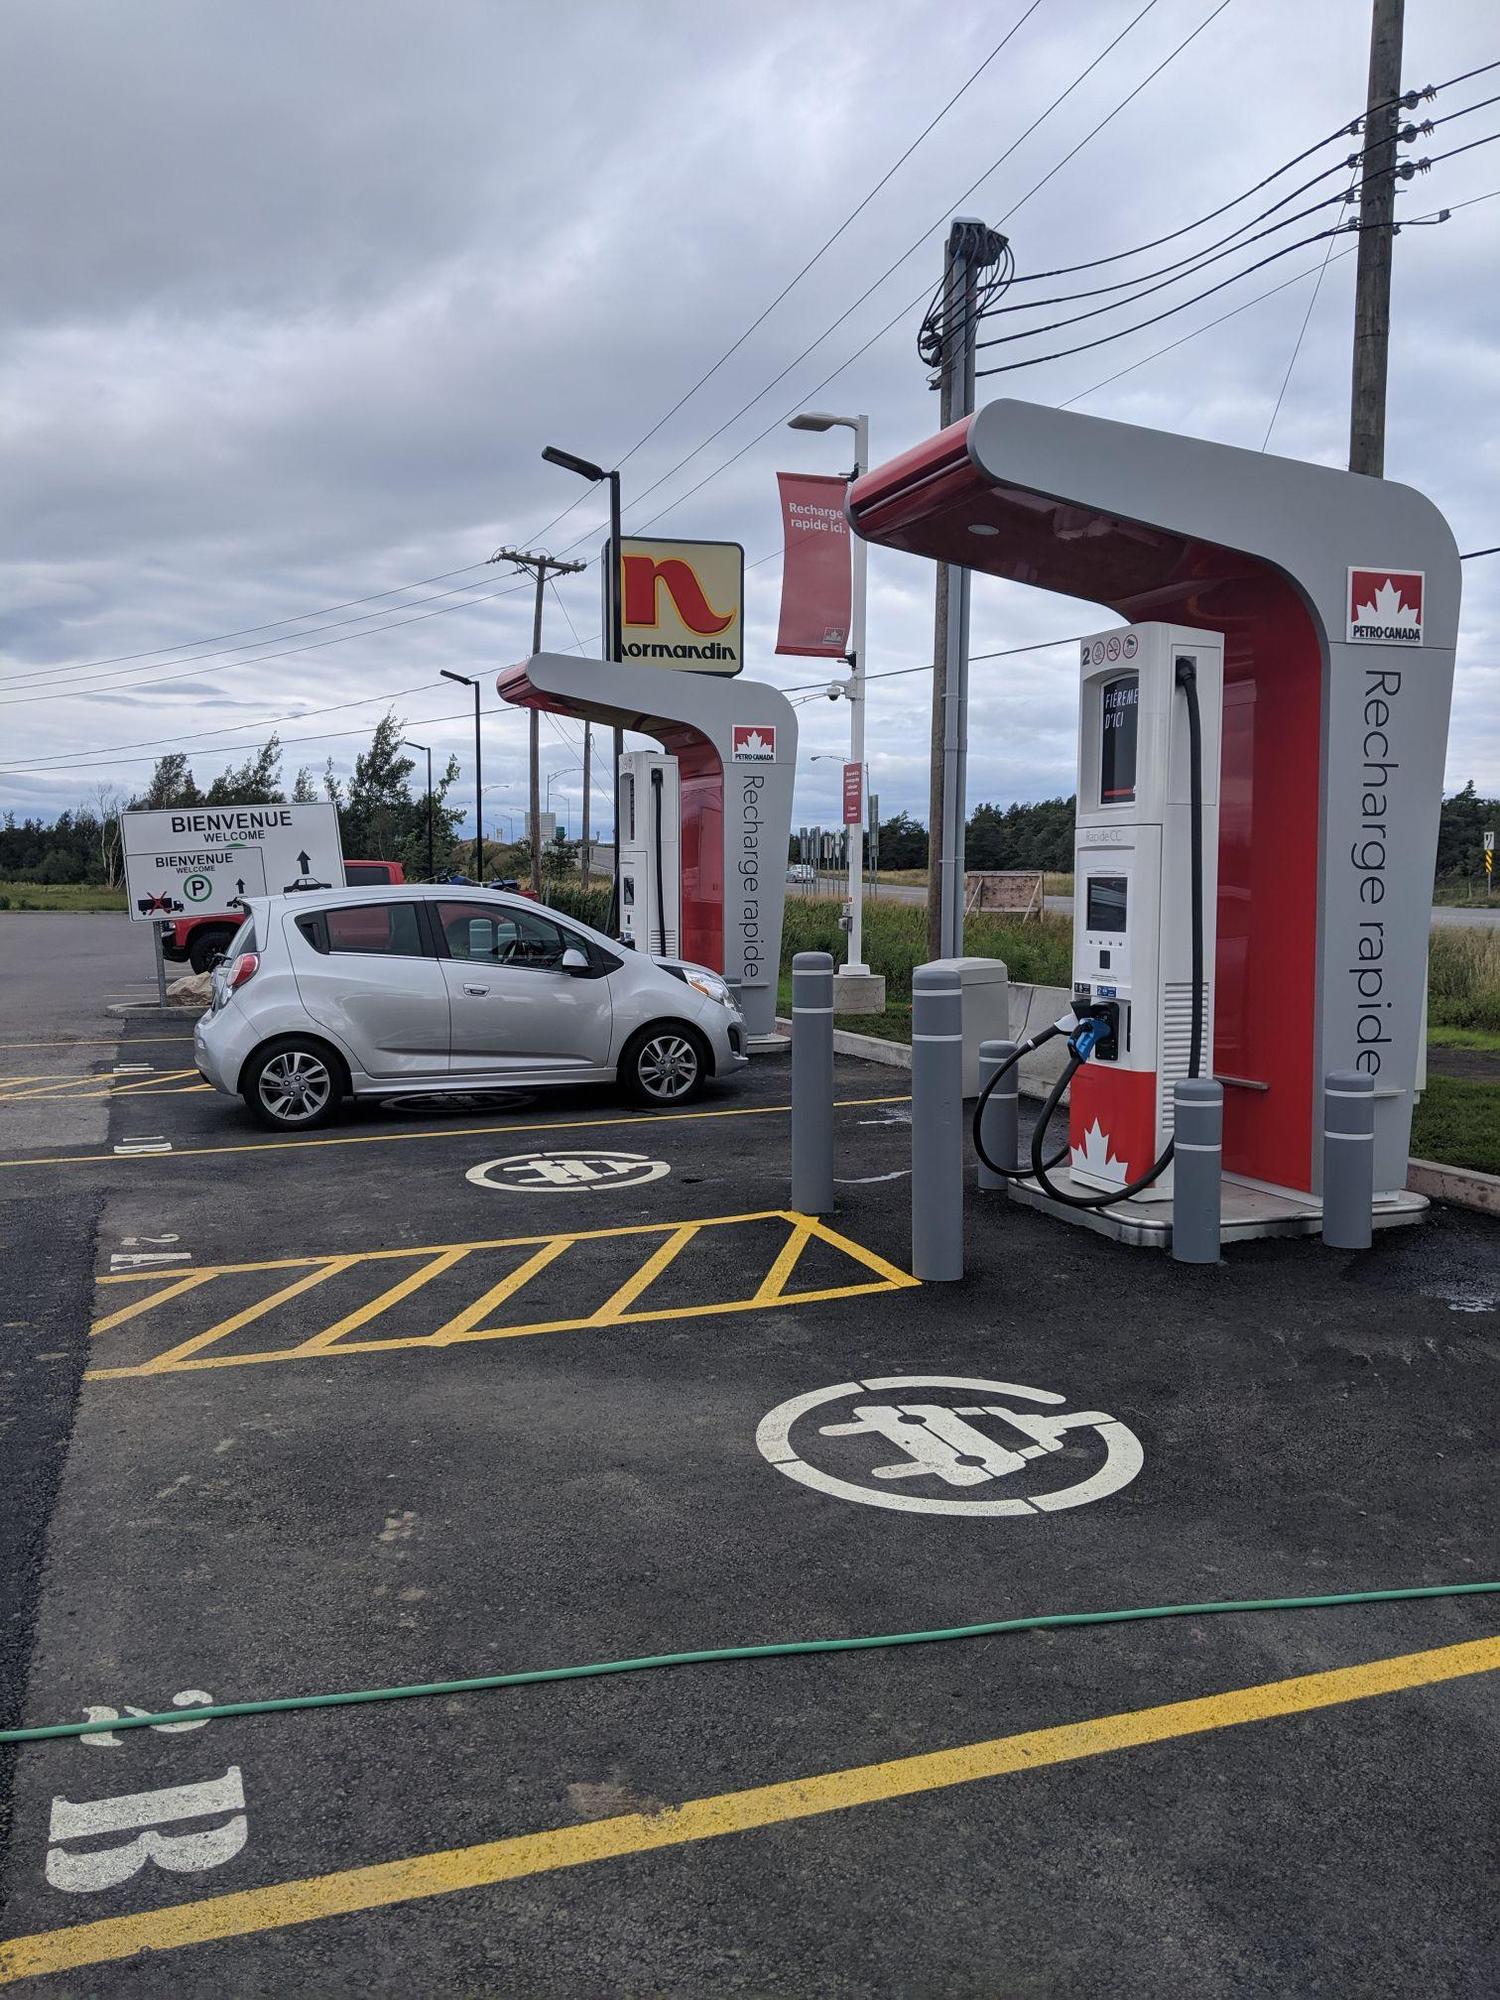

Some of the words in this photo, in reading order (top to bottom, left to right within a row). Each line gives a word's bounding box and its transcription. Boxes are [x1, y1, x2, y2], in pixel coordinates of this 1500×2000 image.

[788, 502, 843, 520] Recharge
[791, 518, 829, 531] rapide
[1353, 625, 1421, 640] PETRO-CANADA
[1082, 647, 1091, 666] 2
[1351, 670, 1402, 905] Recharge
[171, 811, 293, 833] BIENVENUE
[203, 830, 266, 843] WELCOME
[738, 775, 765, 892] Recharge
[155, 853, 234, 868] BIENVENUE
[176, 865, 216, 874] WELCOME
[738, 899, 765, 978] rapide
[1349, 922, 1393, 1076] rapide
